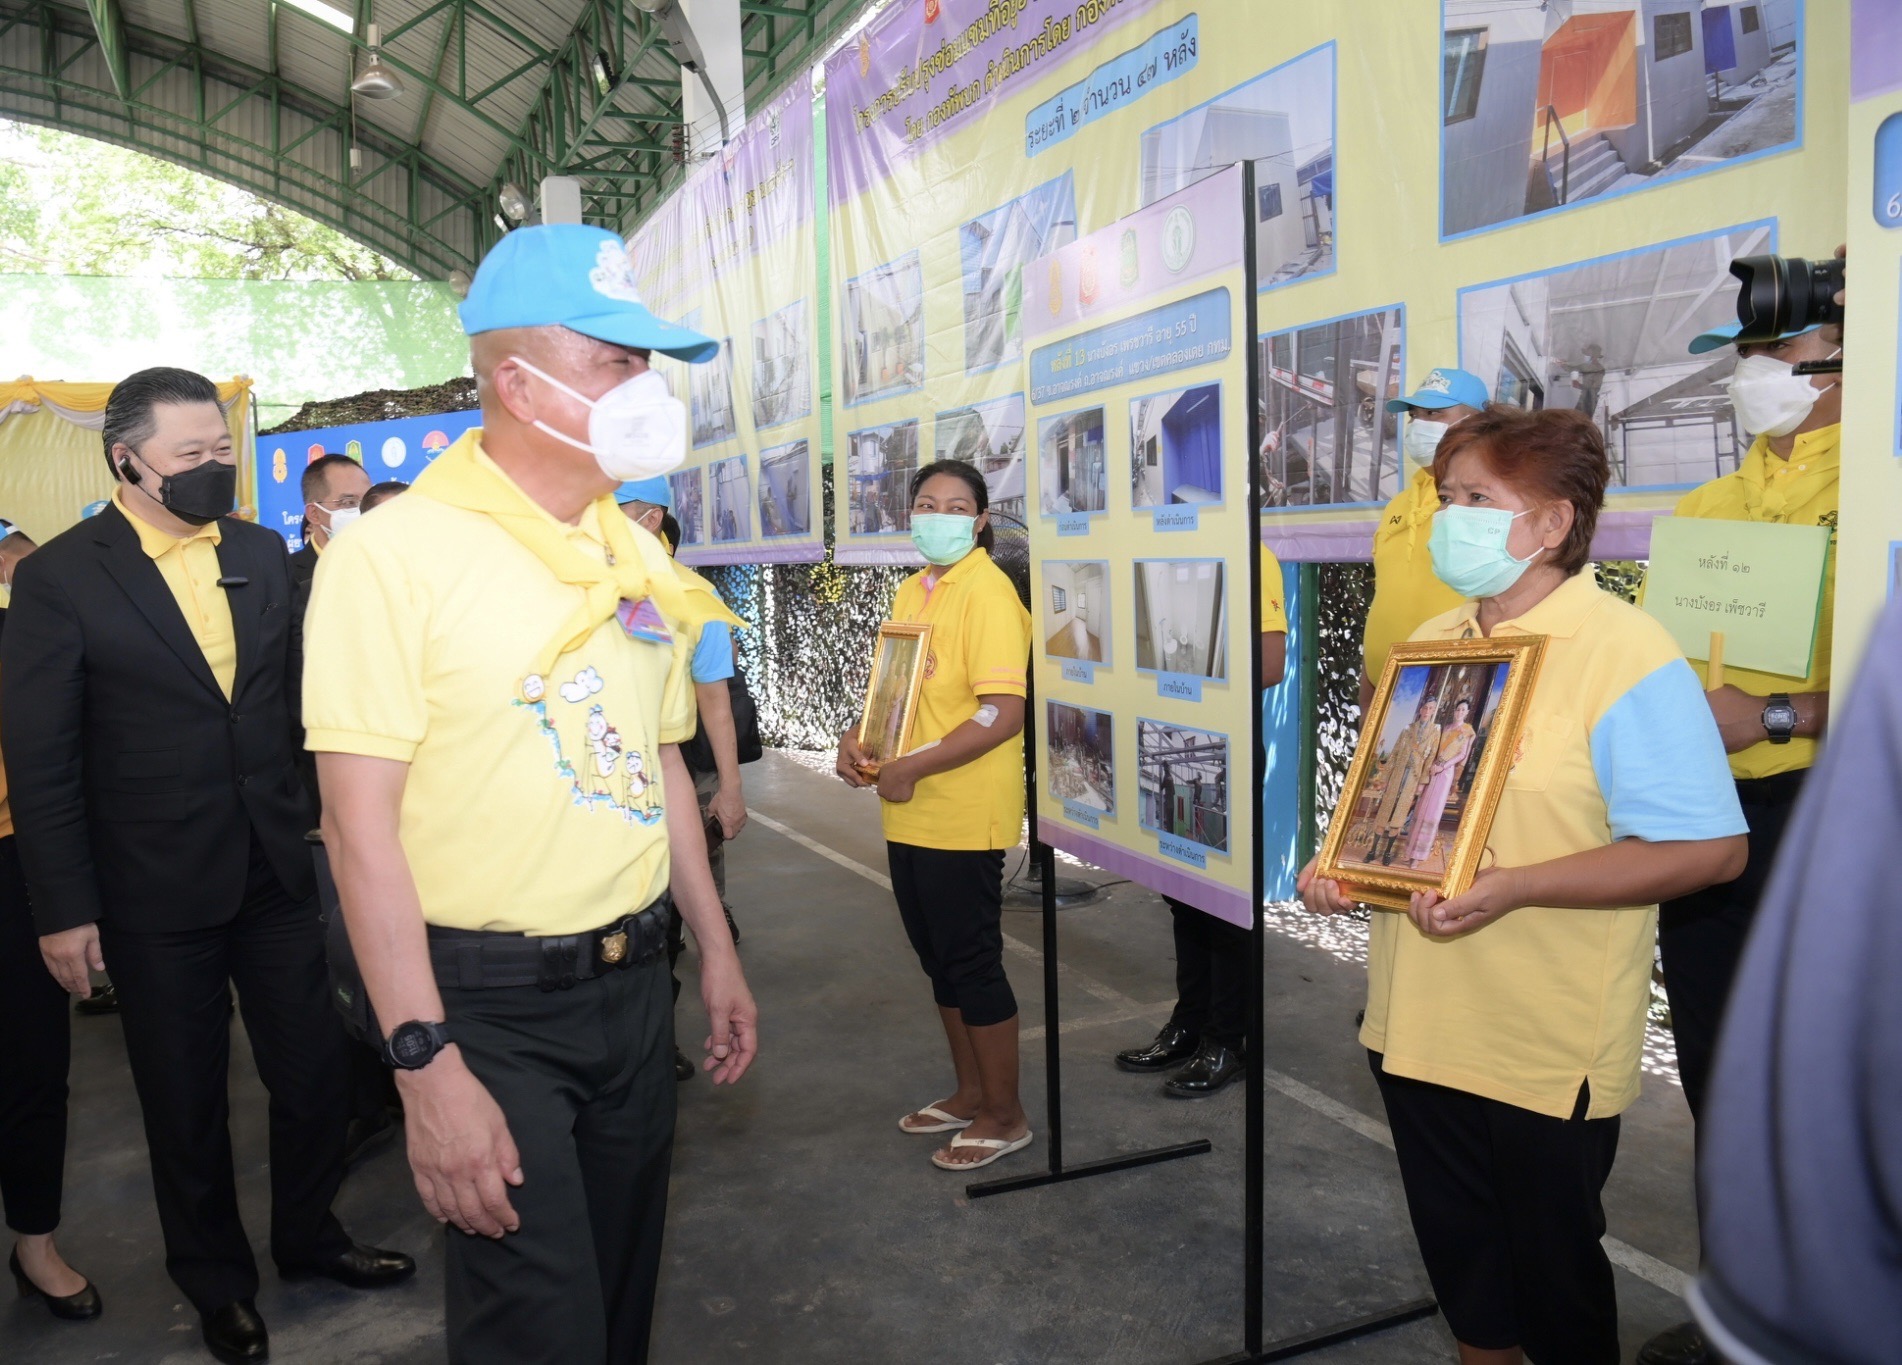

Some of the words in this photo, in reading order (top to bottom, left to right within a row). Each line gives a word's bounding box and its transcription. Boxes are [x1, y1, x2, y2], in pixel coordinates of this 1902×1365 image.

[1028, 97, 1066, 149] ระยะที่
[1164, 28, 1197, 71] หลัง
[926, 84, 981, 132] กองทัพบก
[1698, 551, 1729, 571] หลังที่
[1732, 563, 1751, 574] ๑๒
[1674, 595, 1722, 612] นางบังอร
